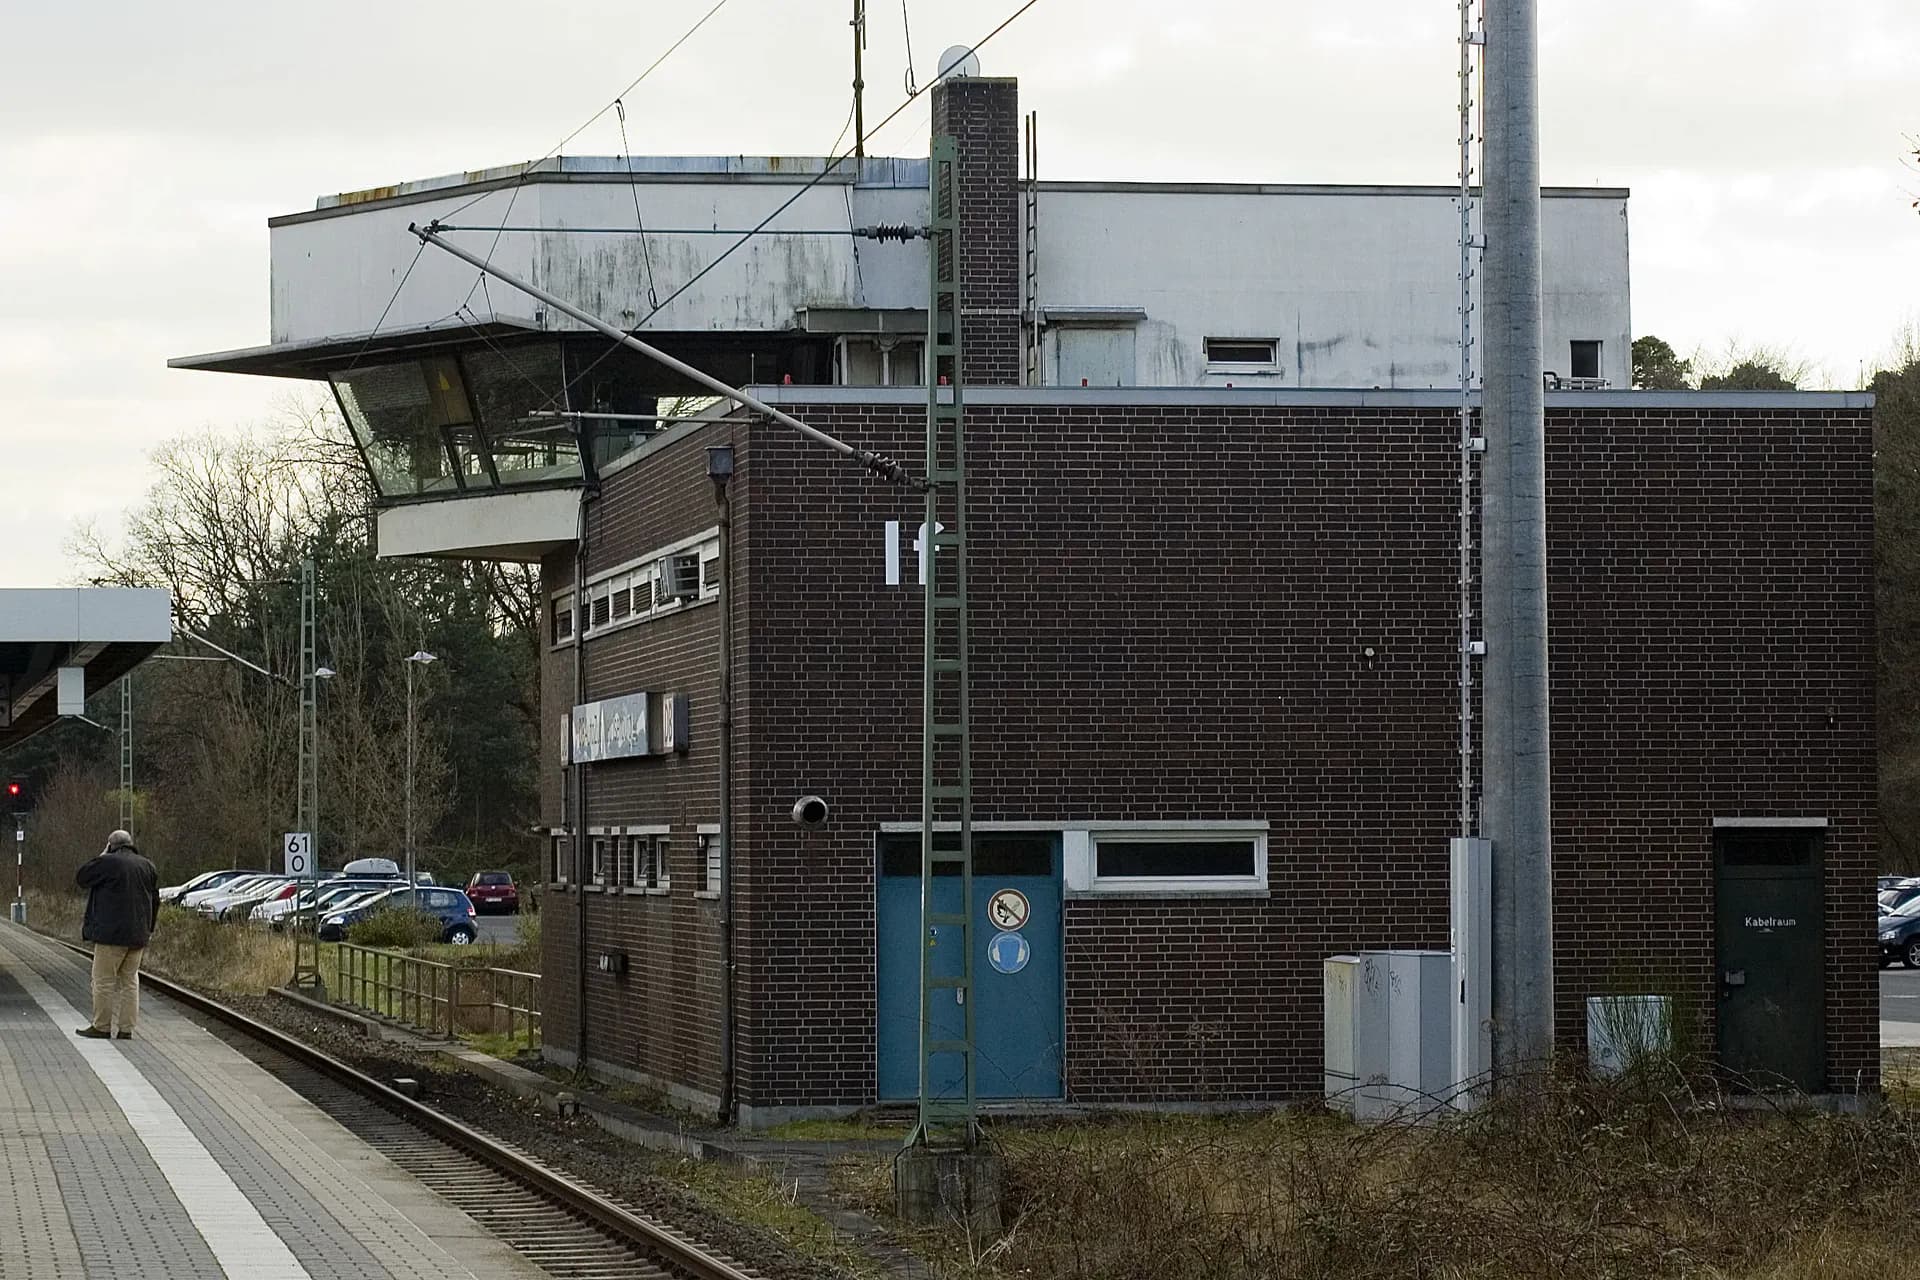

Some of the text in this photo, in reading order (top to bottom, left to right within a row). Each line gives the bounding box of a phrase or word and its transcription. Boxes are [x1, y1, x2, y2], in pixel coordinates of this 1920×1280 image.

[288, 836, 307, 853] 61
[292, 855, 304, 872] 0
[1745, 916, 1796, 927] Kabelraum
